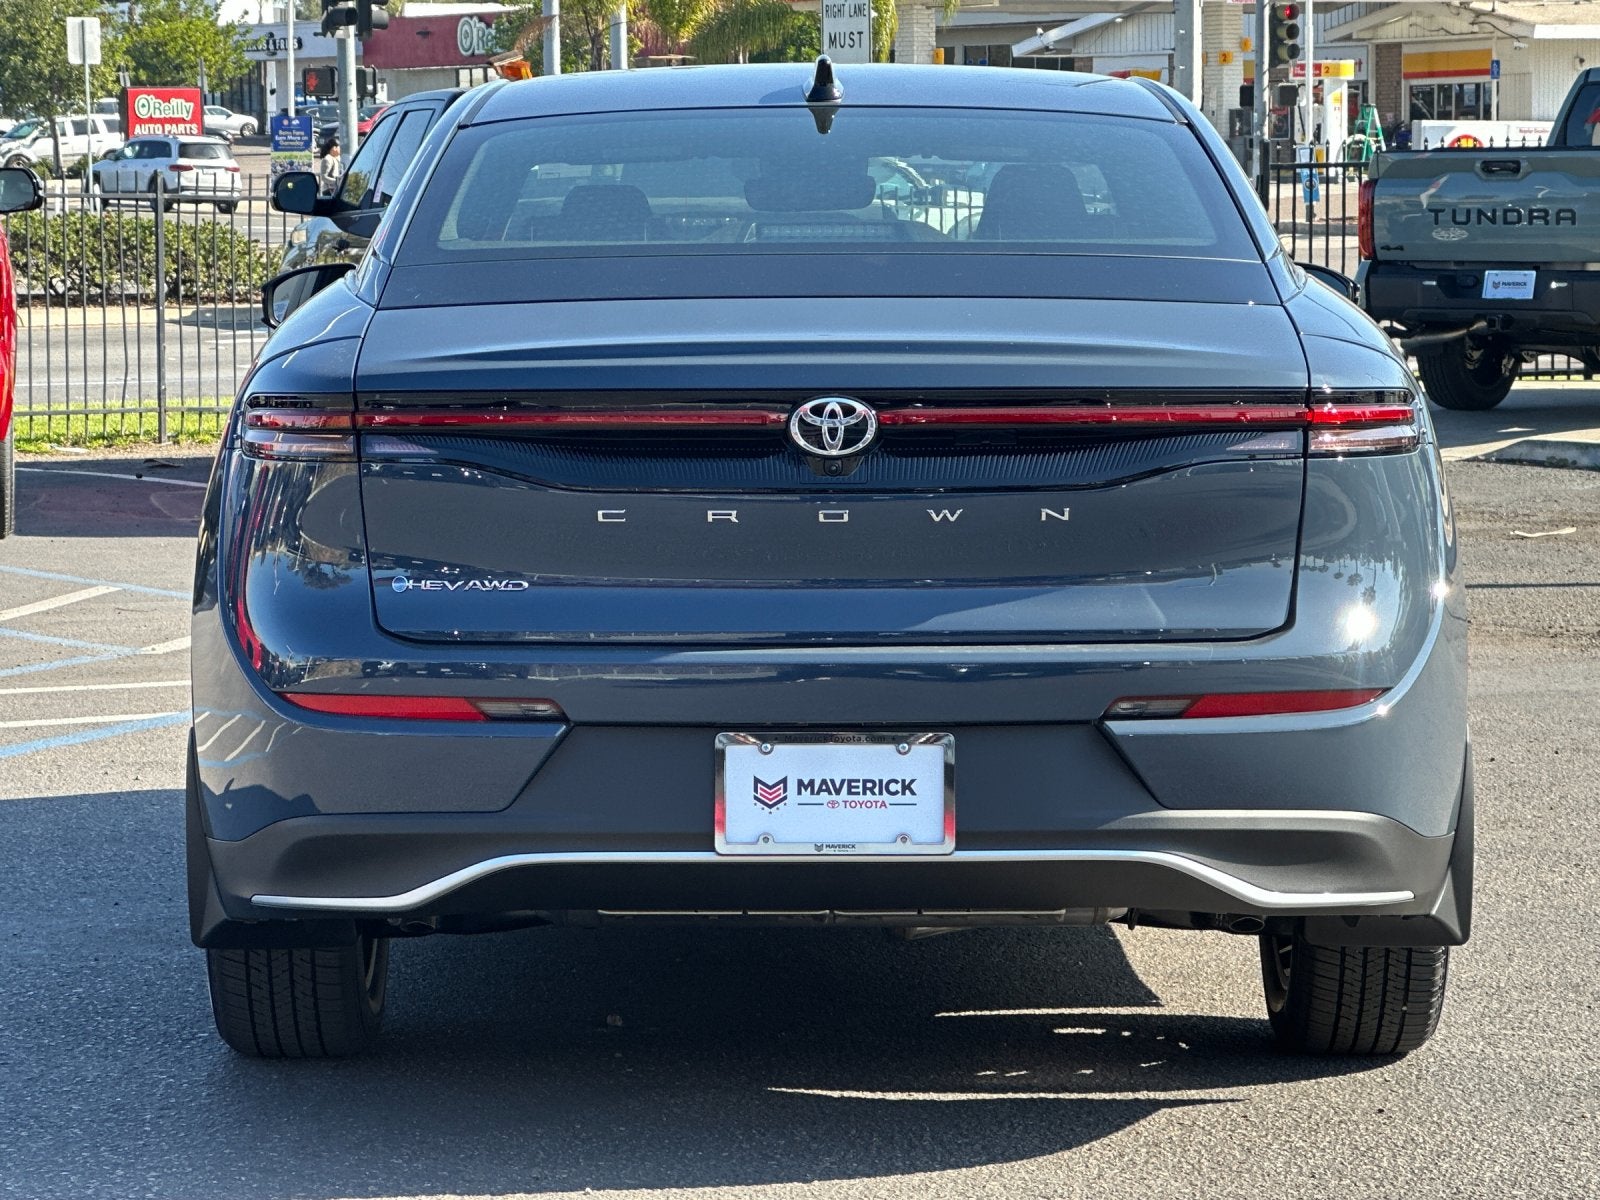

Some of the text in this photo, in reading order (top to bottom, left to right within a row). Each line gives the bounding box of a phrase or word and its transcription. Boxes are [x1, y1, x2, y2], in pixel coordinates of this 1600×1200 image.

[825, 3, 867, 18] RIGHT LANE
[275, 37, 299, 51] FRIS
[828, 31, 864, 49] MUST
[135, 94, 194, 121] O'Reilly
[134, 123, 198, 135] AUTO PARTS
[1427, 208, 1578, 226] TUNDRA
[597, 507, 1071, 523] CROWN
[797, 778, 918, 796] MAVERICK
[841, 799, 888, 809] TOYOTA
